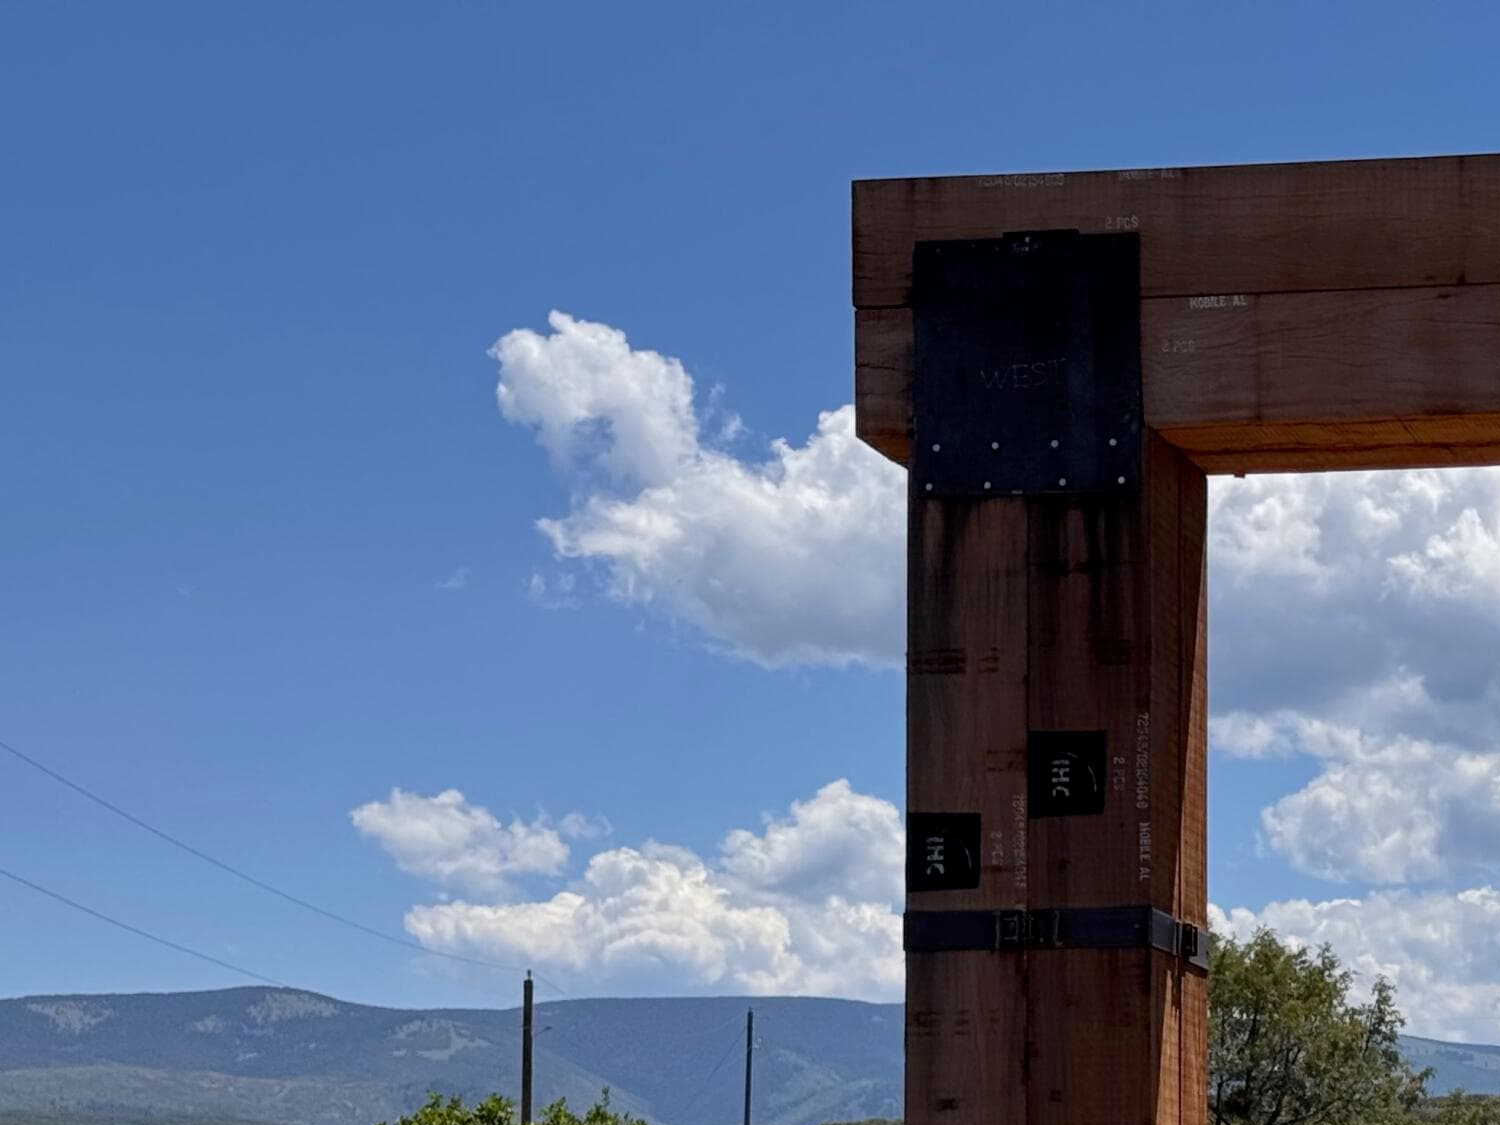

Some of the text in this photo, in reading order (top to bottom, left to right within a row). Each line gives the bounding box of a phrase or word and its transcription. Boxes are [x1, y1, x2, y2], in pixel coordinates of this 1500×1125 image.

[1105, 216, 1113, 230] 2
[979, 357, 1067, 391] WEST
[1112, 756, 1126, 765] 2
[1051, 759, 1071, 797] IHC
[926, 836, 945, 875] IHC
